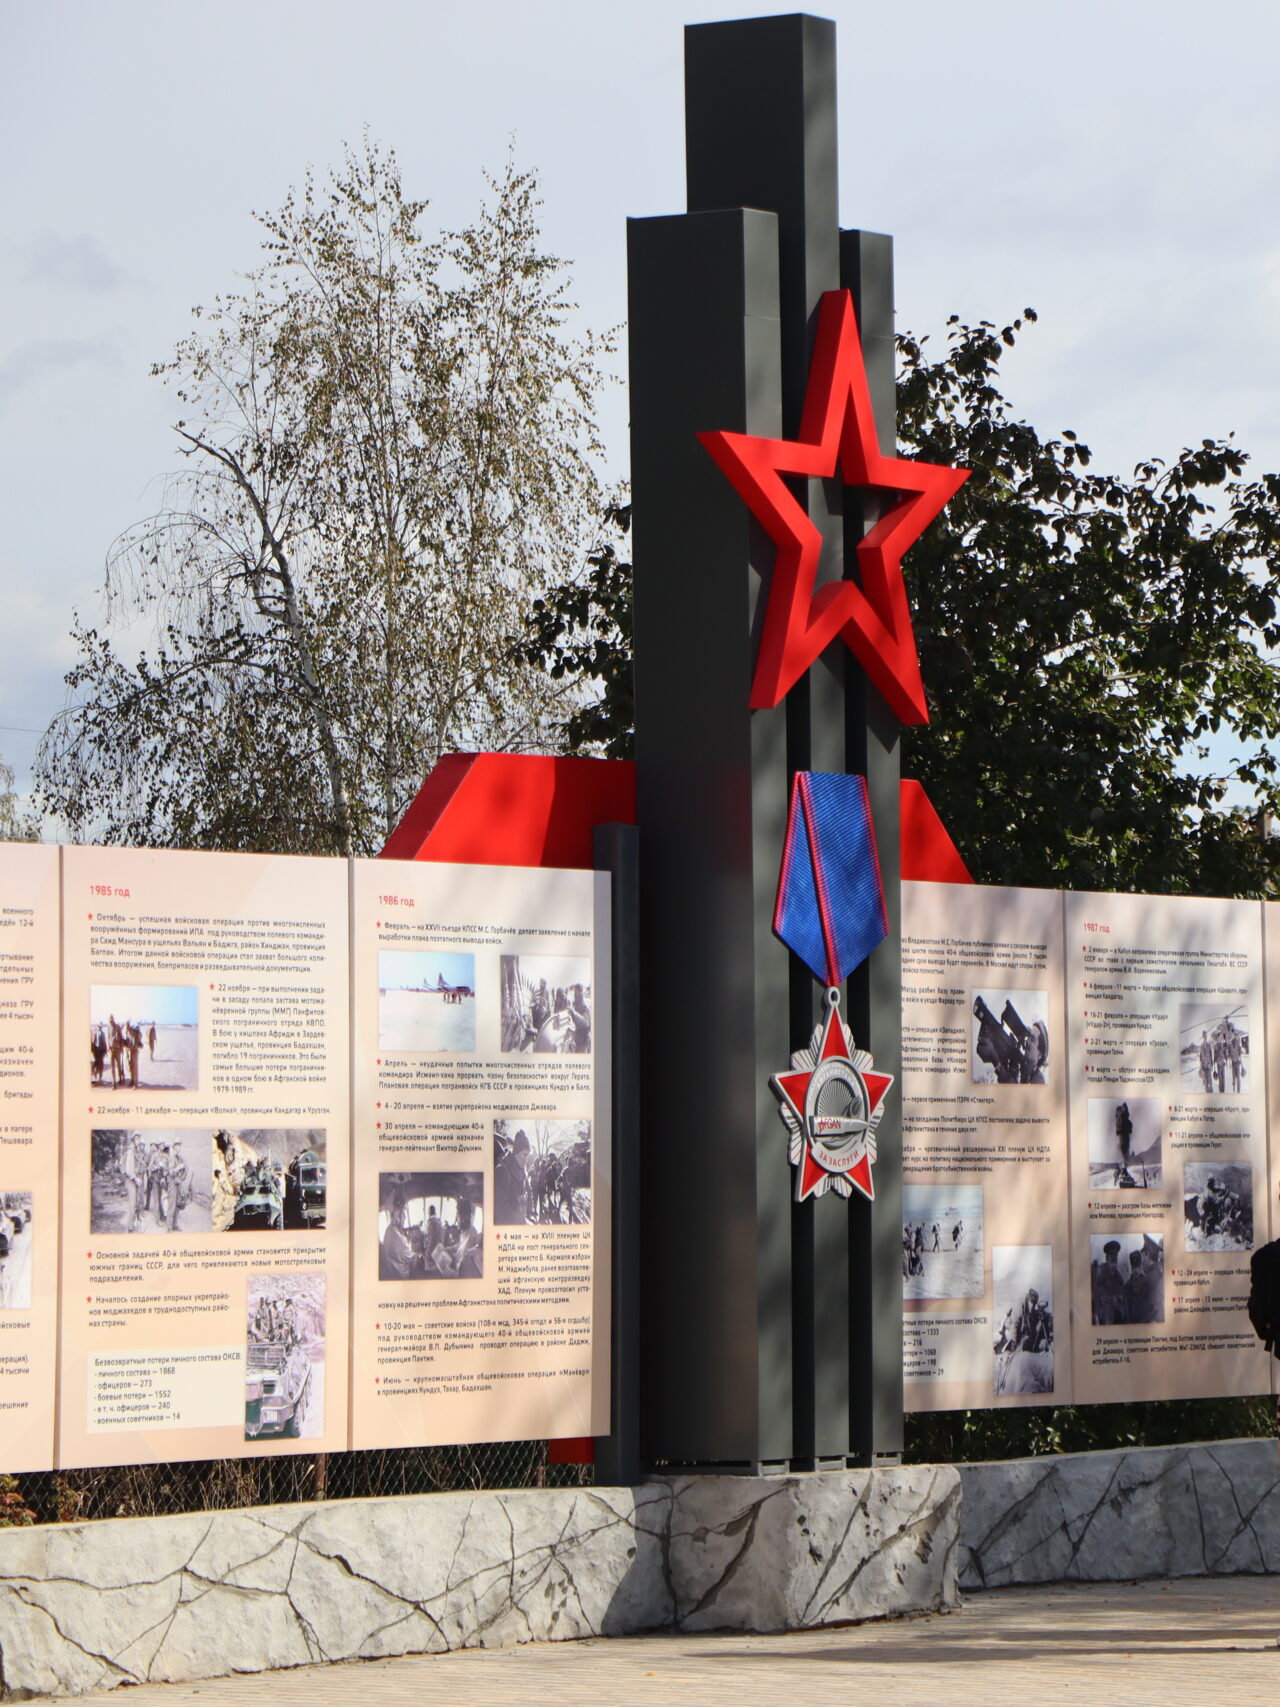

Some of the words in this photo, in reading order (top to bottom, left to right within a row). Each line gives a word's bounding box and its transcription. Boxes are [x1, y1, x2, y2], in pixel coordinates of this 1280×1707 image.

[90, 885, 112, 896] 1985
[114, 888, 130, 897] год
[378, 895, 398, 905] 1986
[400, 898, 414, 907] год
[96, 913, 126, 922] Октябрь
[19, 919, 33, 927] 12-й
[1083, 922, 1098, 932] 1987
[1099, 925, 1110, 933] год
[90, 926, 136, 934] вооружённых
[189, 927, 204, 935] ИПА
[18, 1045, 33, 1053] 40-й
[213, 1085, 246, 1093] 1979-1989
[3, 1090, 33, 1098] бригады
[97, 1106, 105, 1114] 22
[107, 1106, 130, 1114] ноября
[144, 1106, 171, 1114] декабря
[818, 1150, 828, 1164] ЗА
[828, 1150, 860, 1168] ЗАСЛУГИ
[96, 1250, 129, 1259] Основной
[162, 1249, 176, 1257] 40-й
[293, 1247, 326, 1255] прикрытие
[197, 1354, 221, 1362] состава
[159, 1366, 175, 1374] 1868
[98, 1381, 131, 1390] офицеров
[139, 1378, 152, 1387] 273
[98, 1392, 122, 1401] боевые
[154, 1389, 170, 1398] 1552
[116, 1403, 149, 1412] офицеров
[158, 1401, 170, 1409] 240
[172, 1412, 180, 1420] 14
